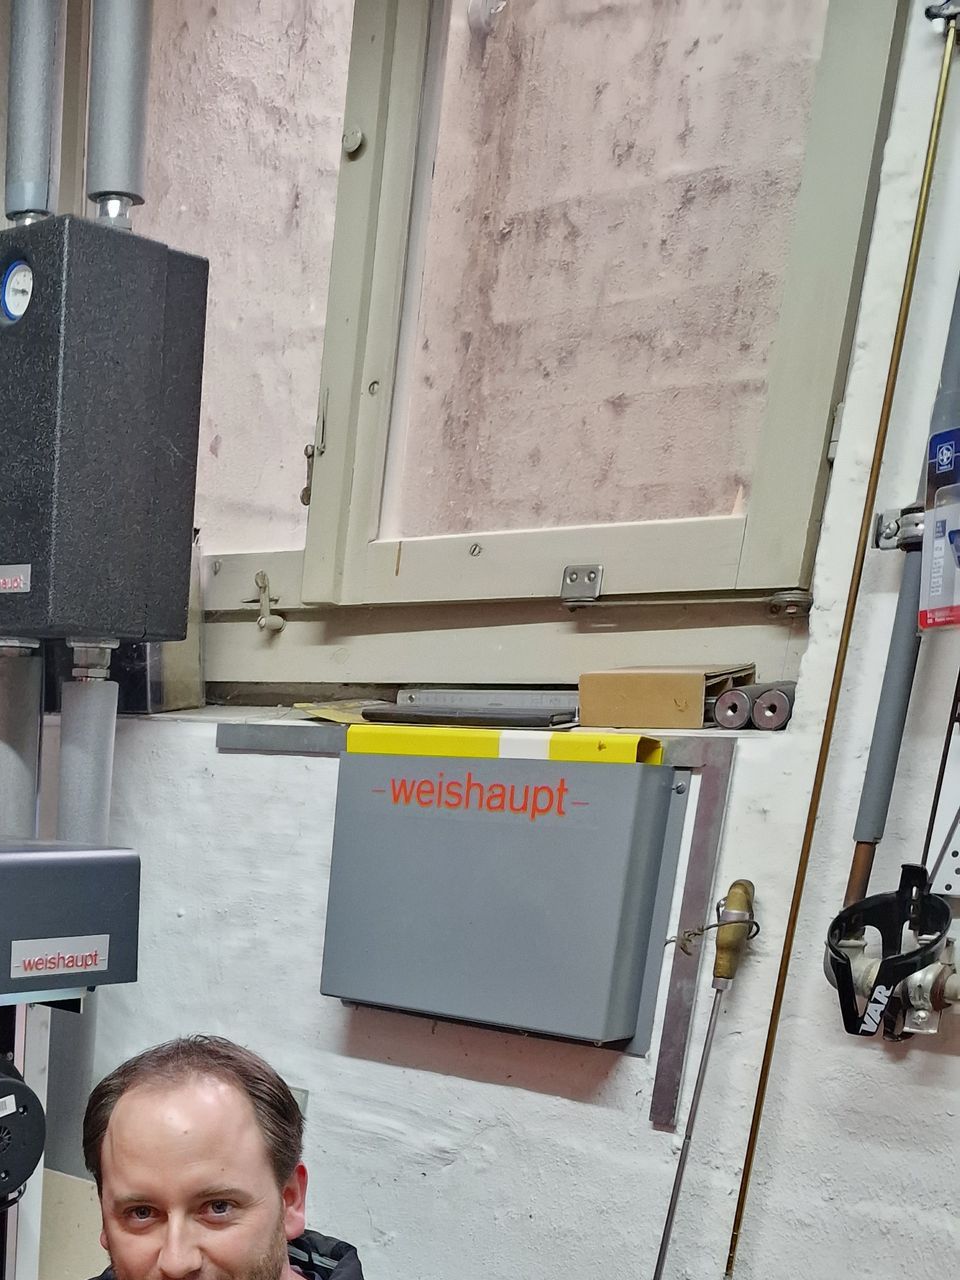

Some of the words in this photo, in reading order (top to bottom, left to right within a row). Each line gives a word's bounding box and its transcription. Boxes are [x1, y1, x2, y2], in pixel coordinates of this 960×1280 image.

[390, 771, 569, 822] weishaupt
[23, 951, 98, 971] weishaupt
[858, 984, 894, 1034] VAR
